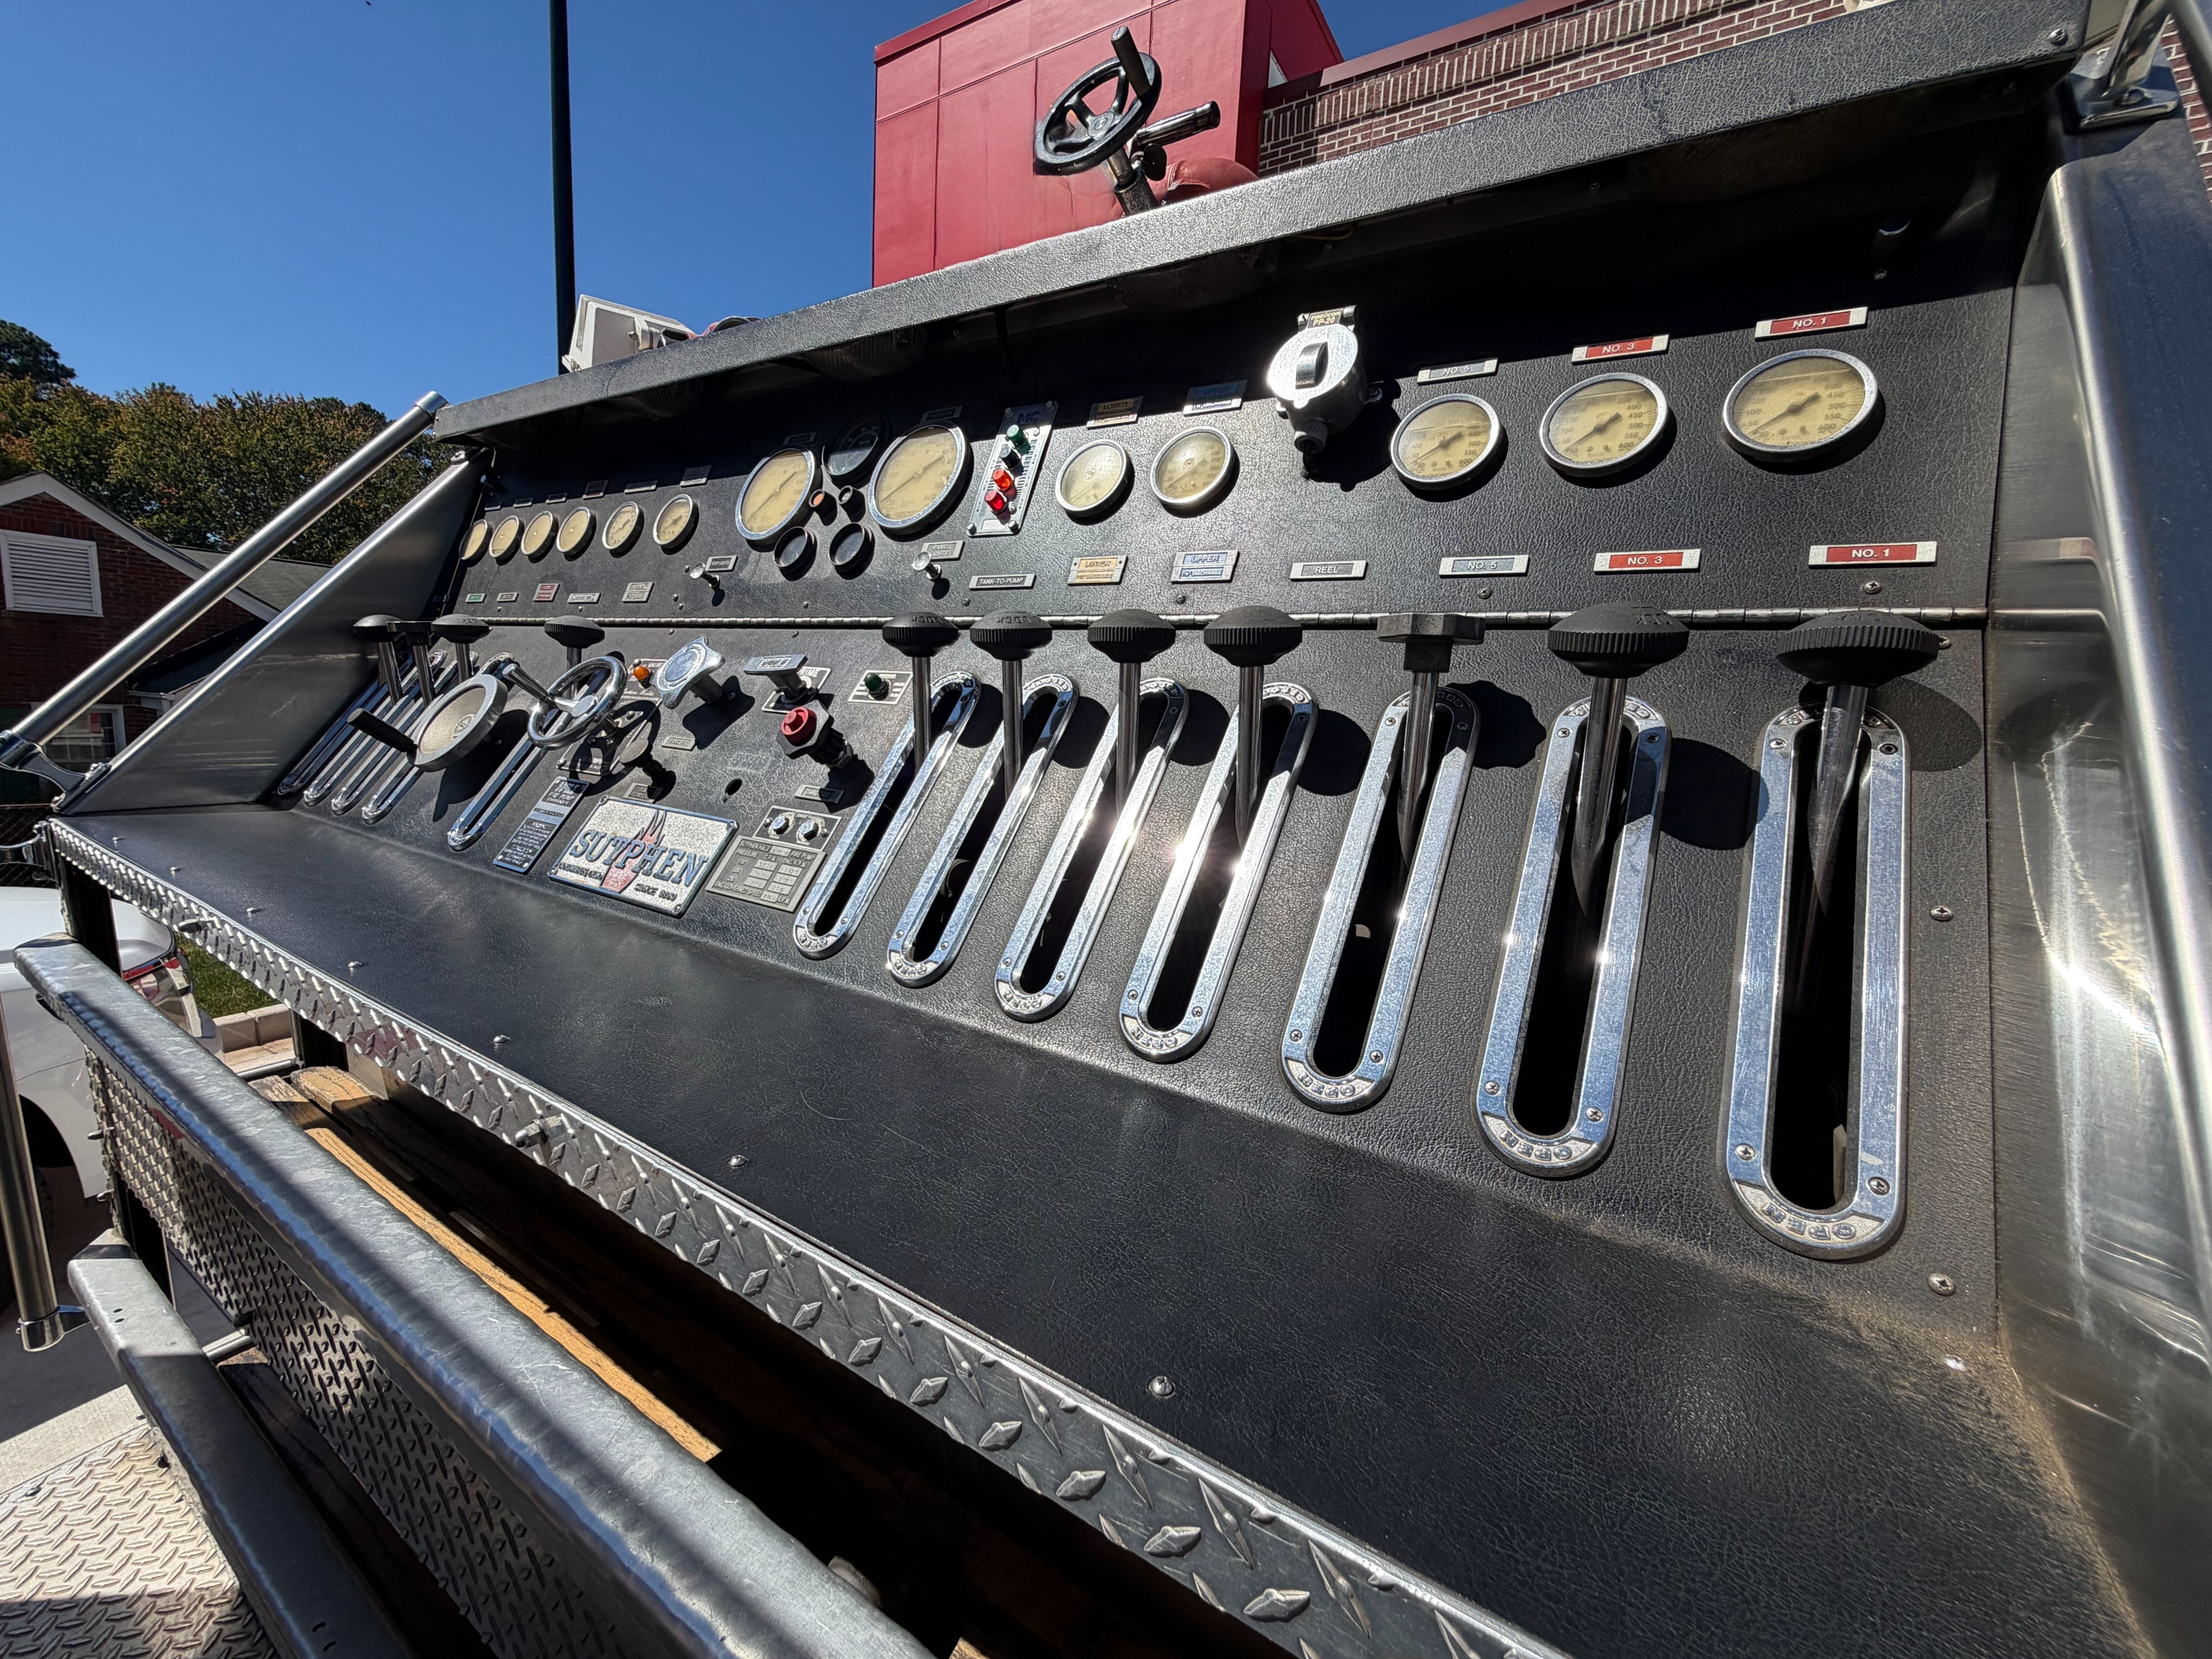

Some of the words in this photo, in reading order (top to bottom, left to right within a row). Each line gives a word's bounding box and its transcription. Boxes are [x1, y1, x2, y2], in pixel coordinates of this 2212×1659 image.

[1312, 317, 1335, 326] PP-20
[1792, 318, 1816, 329] NO.
[1820, 317, 1827, 325] 1
[1602, 344, 1622, 354] NO.
[1443, 367, 1461, 375] NO.
[1851, 549, 1878, 558] NO.
[1882, 548, 1890, 557] 1
[1191, 554, 1220, 563] UPPER
[1627, 557, 1649, 566] NO.
[1654, 556, 1663, 564] 3
[1467, 561, 1486, 570] NO.
[1490, 561, 1498, 569] 5
[734, 849, 759, 858] PRESSURE
[739, 840, 759, 849] SUTPHEN
[799, 853, 815, 861] PUMP
[569, 830, 709, 888] SUTPHEN
[1132, 1026, 1178, 1049] OPEN
